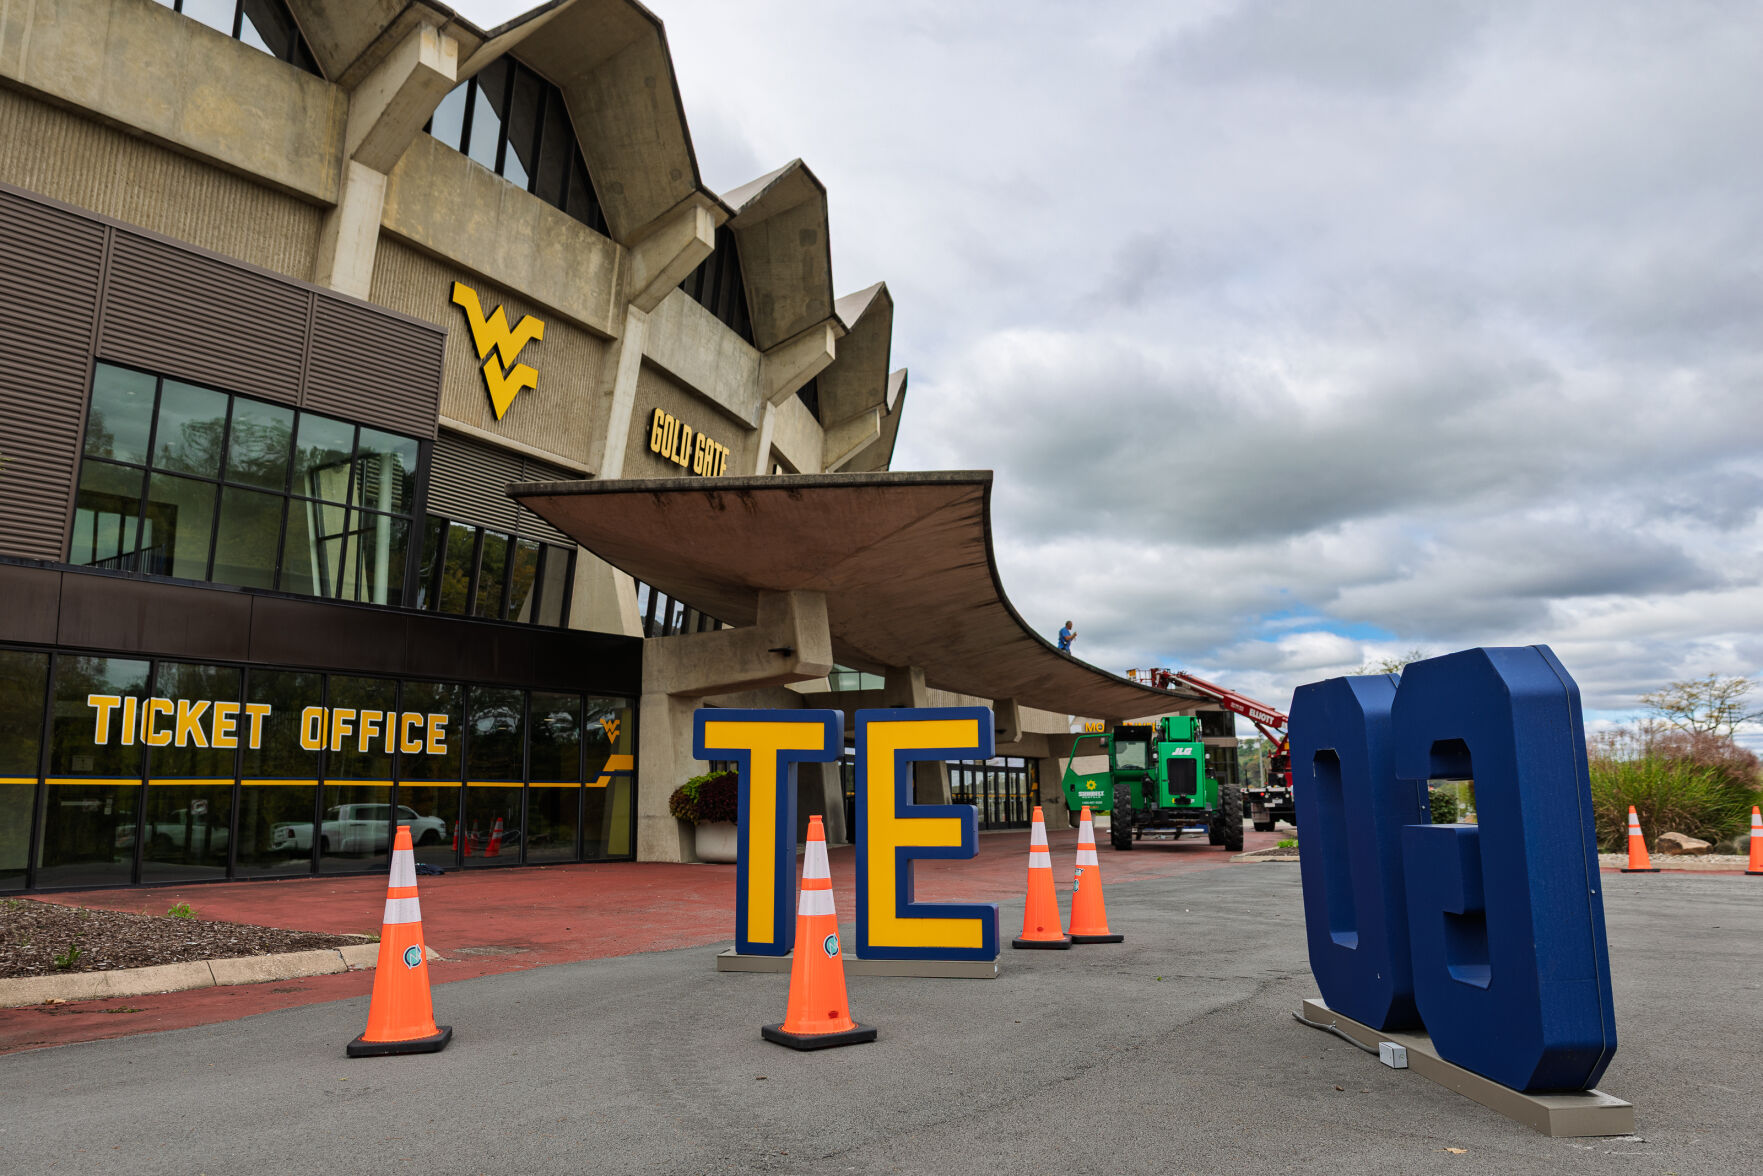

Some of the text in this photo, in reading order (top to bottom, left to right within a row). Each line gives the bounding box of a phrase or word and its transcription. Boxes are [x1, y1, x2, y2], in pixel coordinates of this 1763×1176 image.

[650, 407, 730, 477] GOLD GATE
[88, 694, 449, 754] TICKET OFFICE
[1249, 708, 1275, 725] ELLIOTT
[1171, 747, 1193, 756] JLG
[693, 706, 1000, 961] TE
